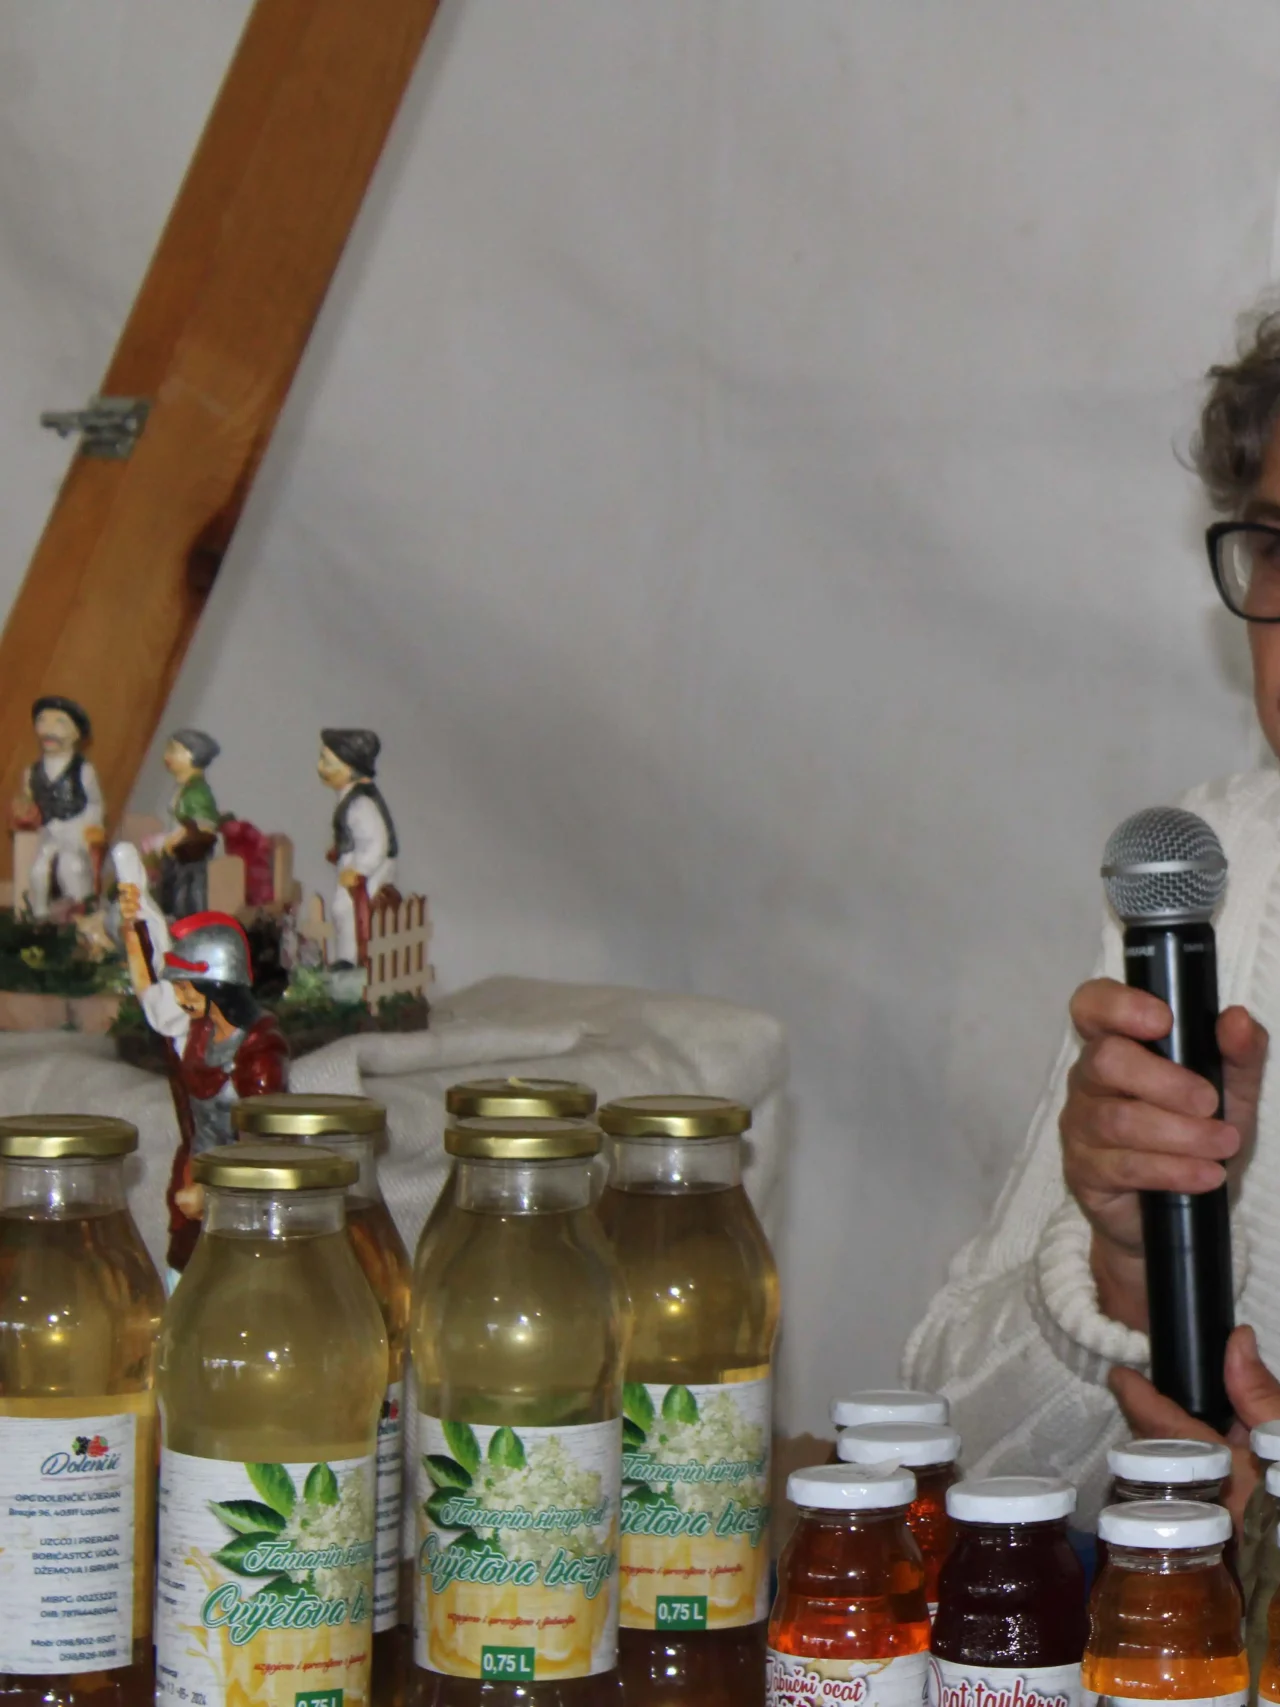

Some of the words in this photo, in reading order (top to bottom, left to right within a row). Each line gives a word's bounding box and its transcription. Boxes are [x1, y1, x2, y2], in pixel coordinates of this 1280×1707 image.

[439, 1497, 532, 1531] Tamarin
[532, 1505, 584, 1535] sirup
[78, 1533, 121, 1545] PRERADA
[242, 1540, 343, 1573] Tamarin
[34, 1565, 83, 1575] DŽEMOVA
[202, 1581, 348, 1646] Cvijetova
[657, 1602, 690, 1624] 0,75
[693, 1603, 704, 1620] L
[483, 1652, 517, 1675] 0,75
[520, 1653, 531, 1673] L
[822, 1680, 863, 1702] ocat
